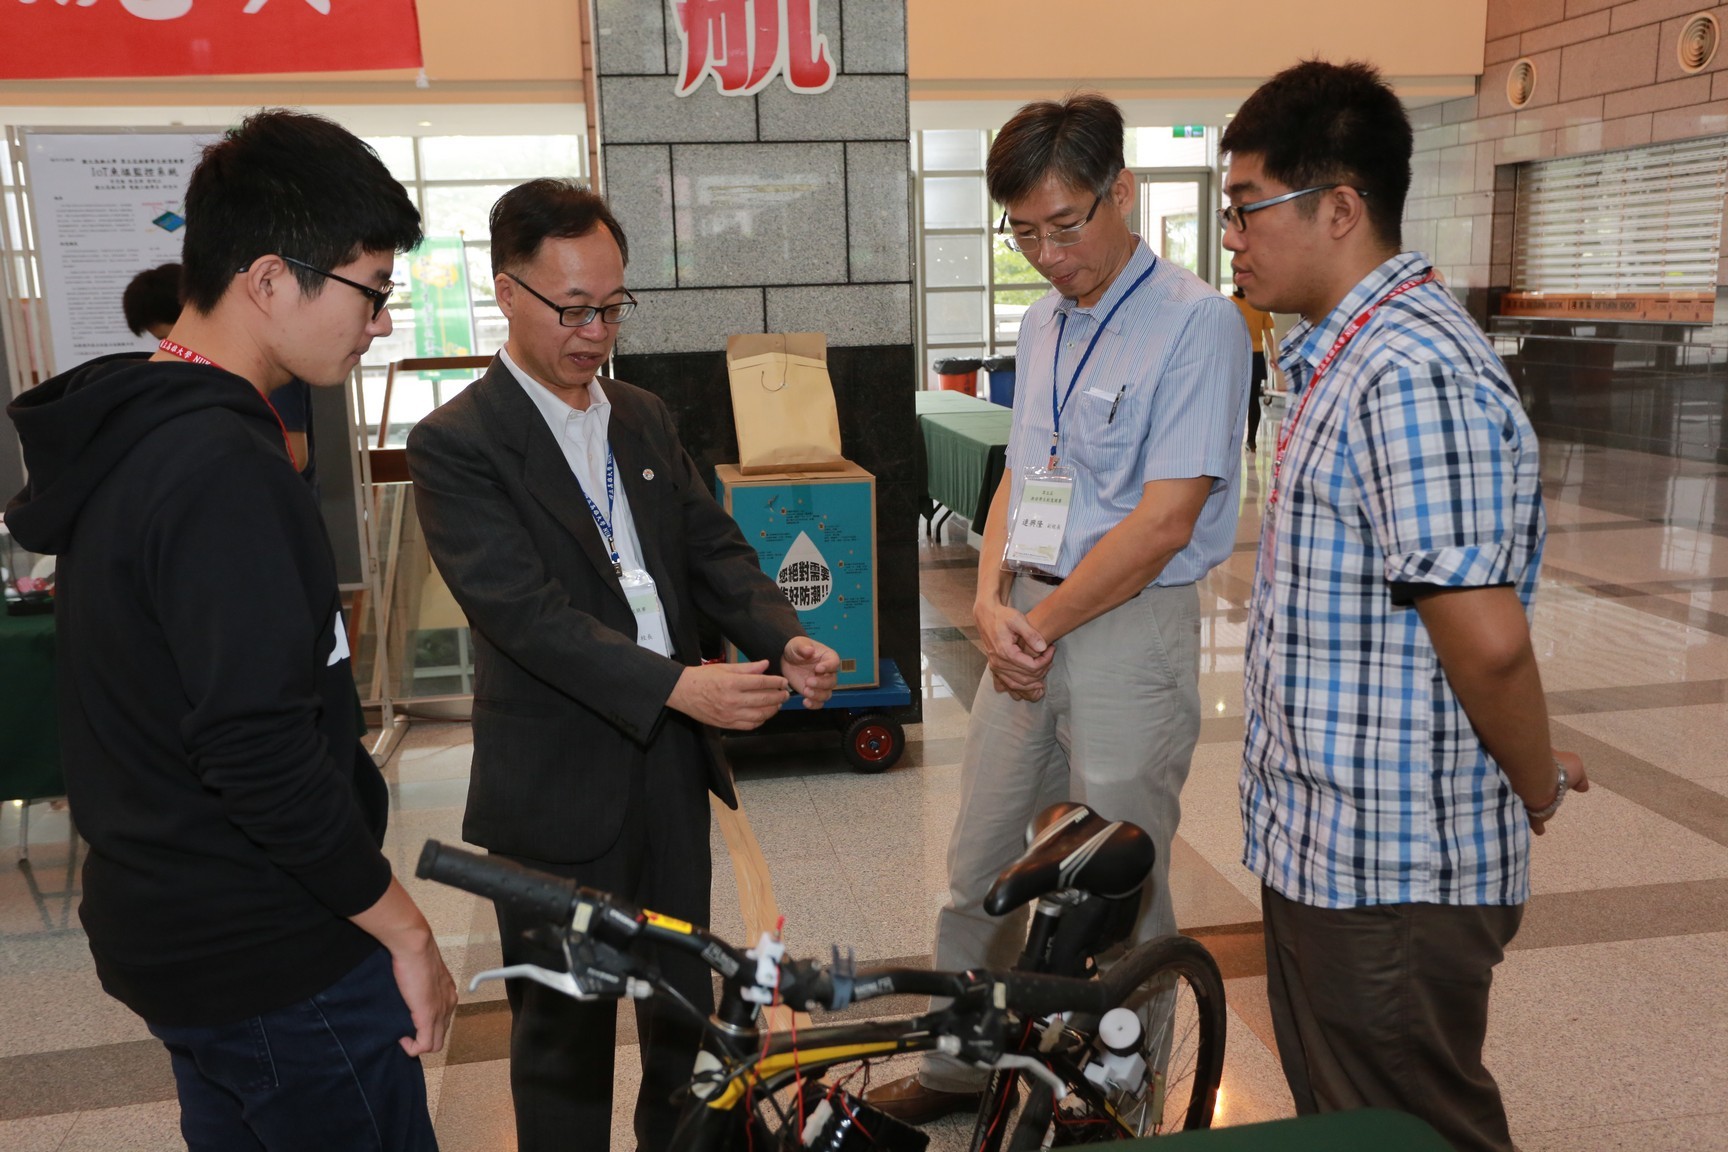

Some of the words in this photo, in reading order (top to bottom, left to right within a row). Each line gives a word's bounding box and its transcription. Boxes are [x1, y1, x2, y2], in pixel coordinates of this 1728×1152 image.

[779, 561, 830, 583] 您絕對需要
